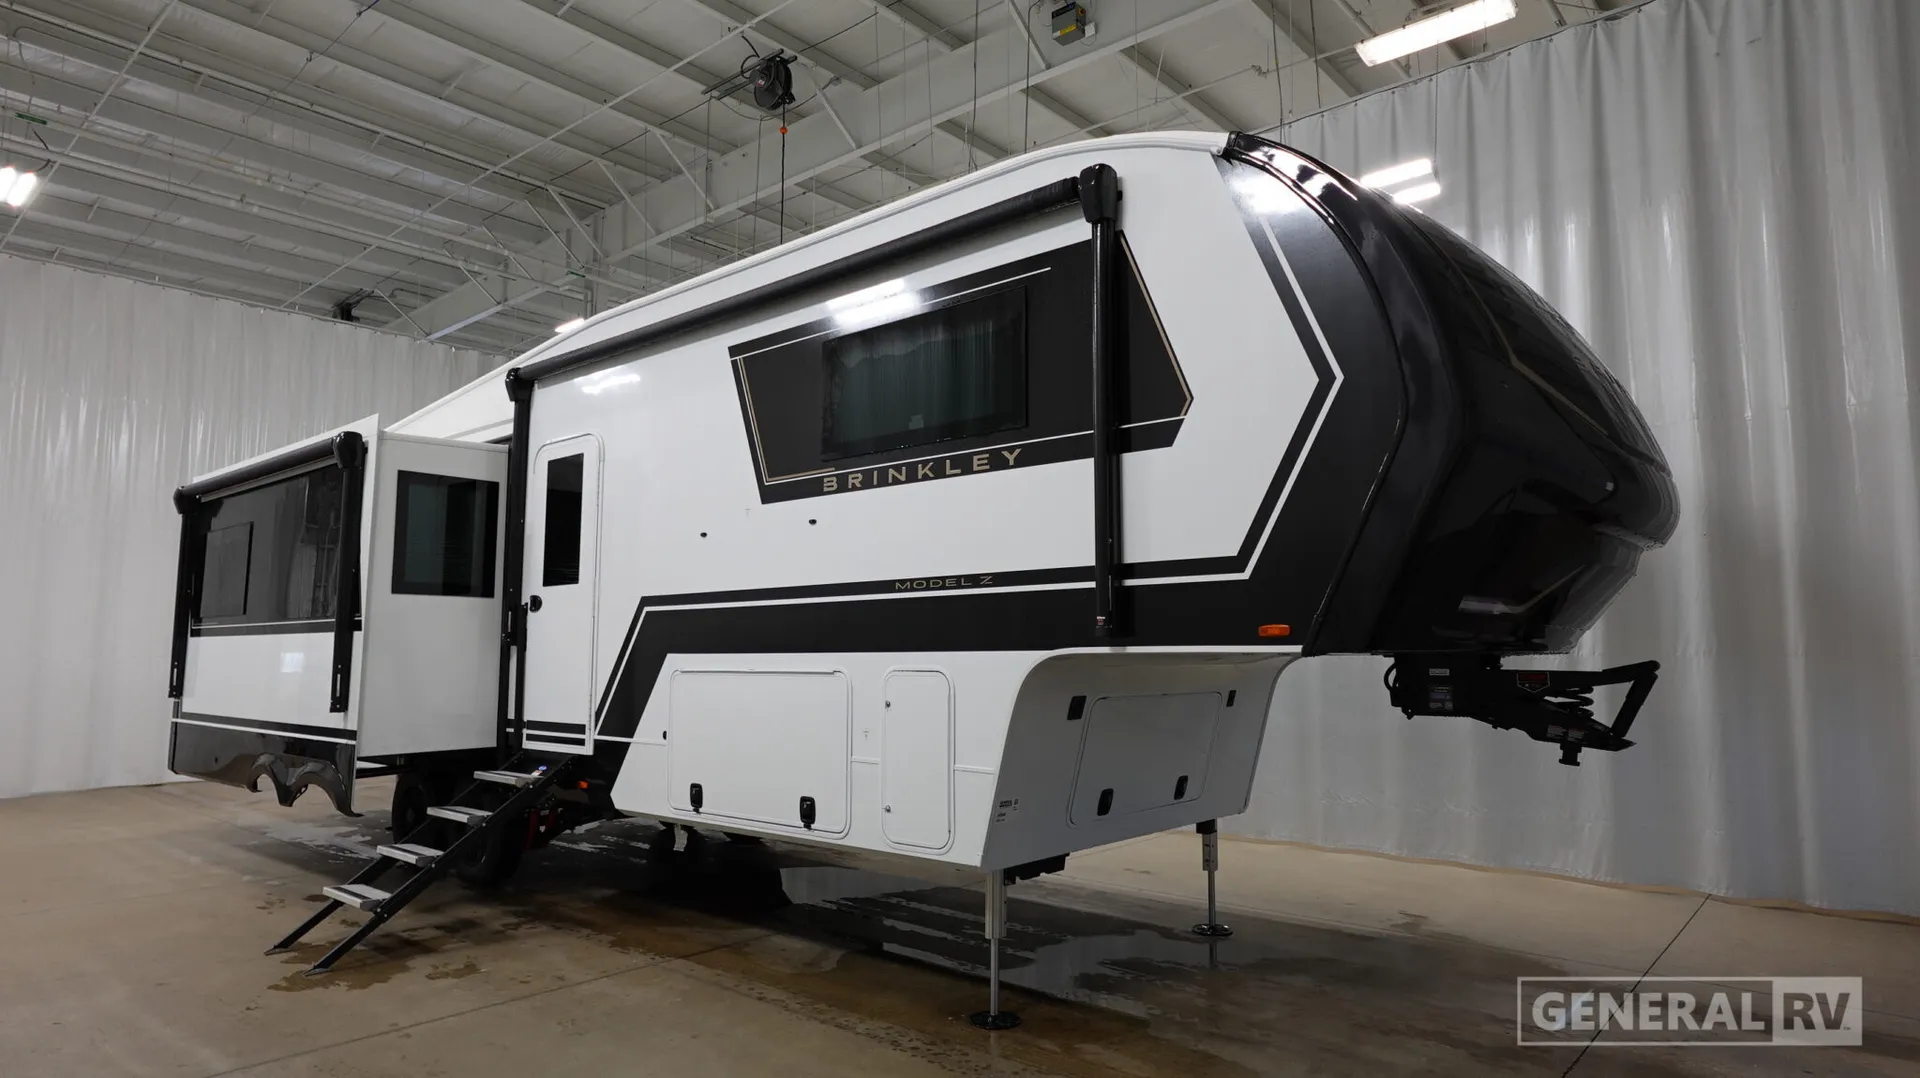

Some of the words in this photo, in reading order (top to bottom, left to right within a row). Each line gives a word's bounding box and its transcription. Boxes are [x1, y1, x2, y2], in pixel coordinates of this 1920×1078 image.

[823, 448, 1022, 492] BRINKLEY
[895, 577, 973, 590] MODEL
[979, 575, 994, 585] Z
